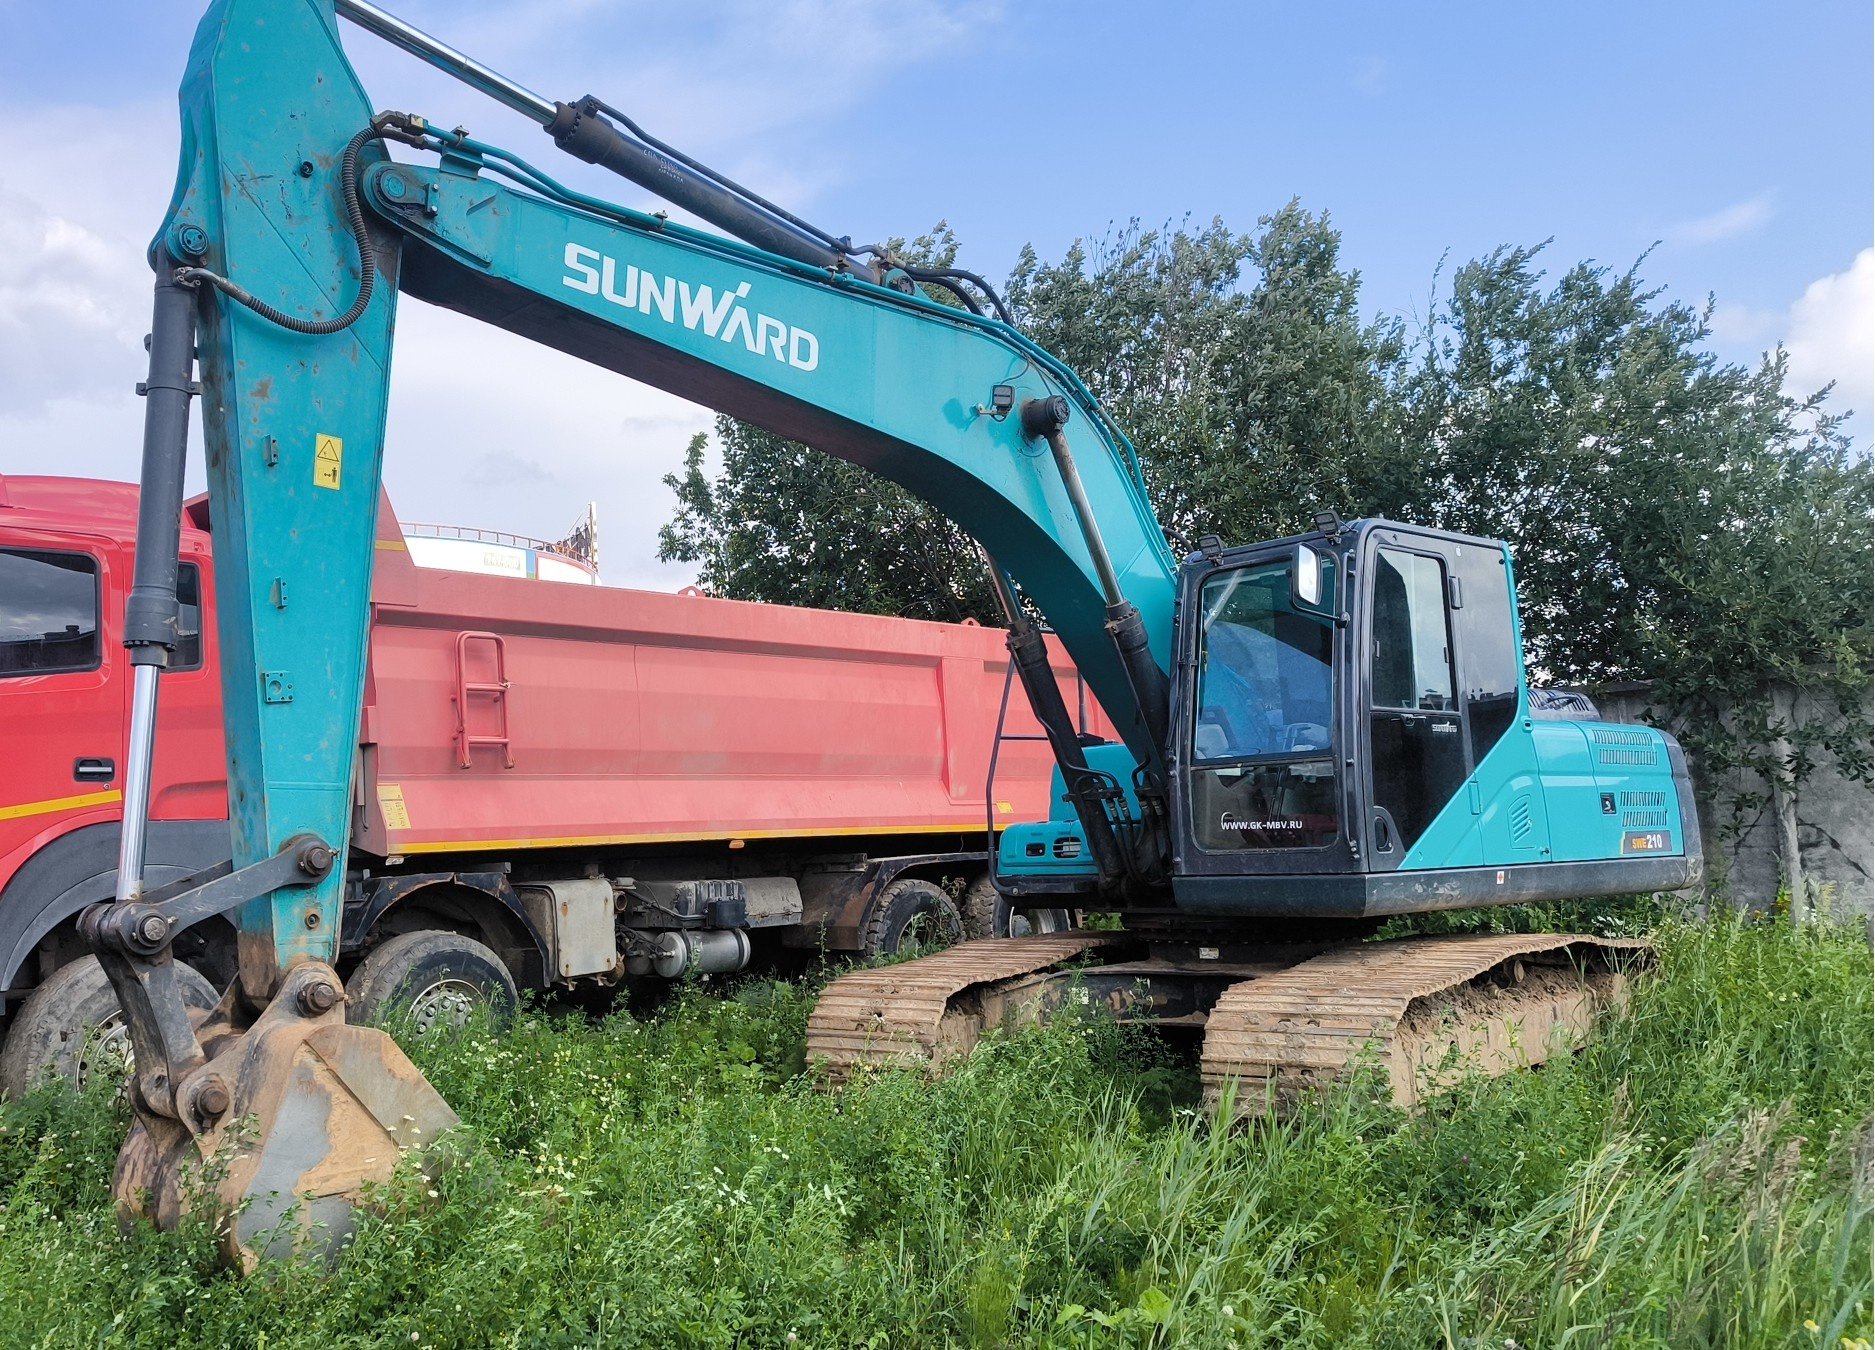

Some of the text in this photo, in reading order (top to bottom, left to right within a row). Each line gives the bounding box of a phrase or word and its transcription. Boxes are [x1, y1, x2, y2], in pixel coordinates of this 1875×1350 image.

[562, 242, 819, 372] SUNWARD
[1221, 820, 1303, 830] WWW.GK-MBV.RU
[1632, 834, 1663, 849] SWE210
